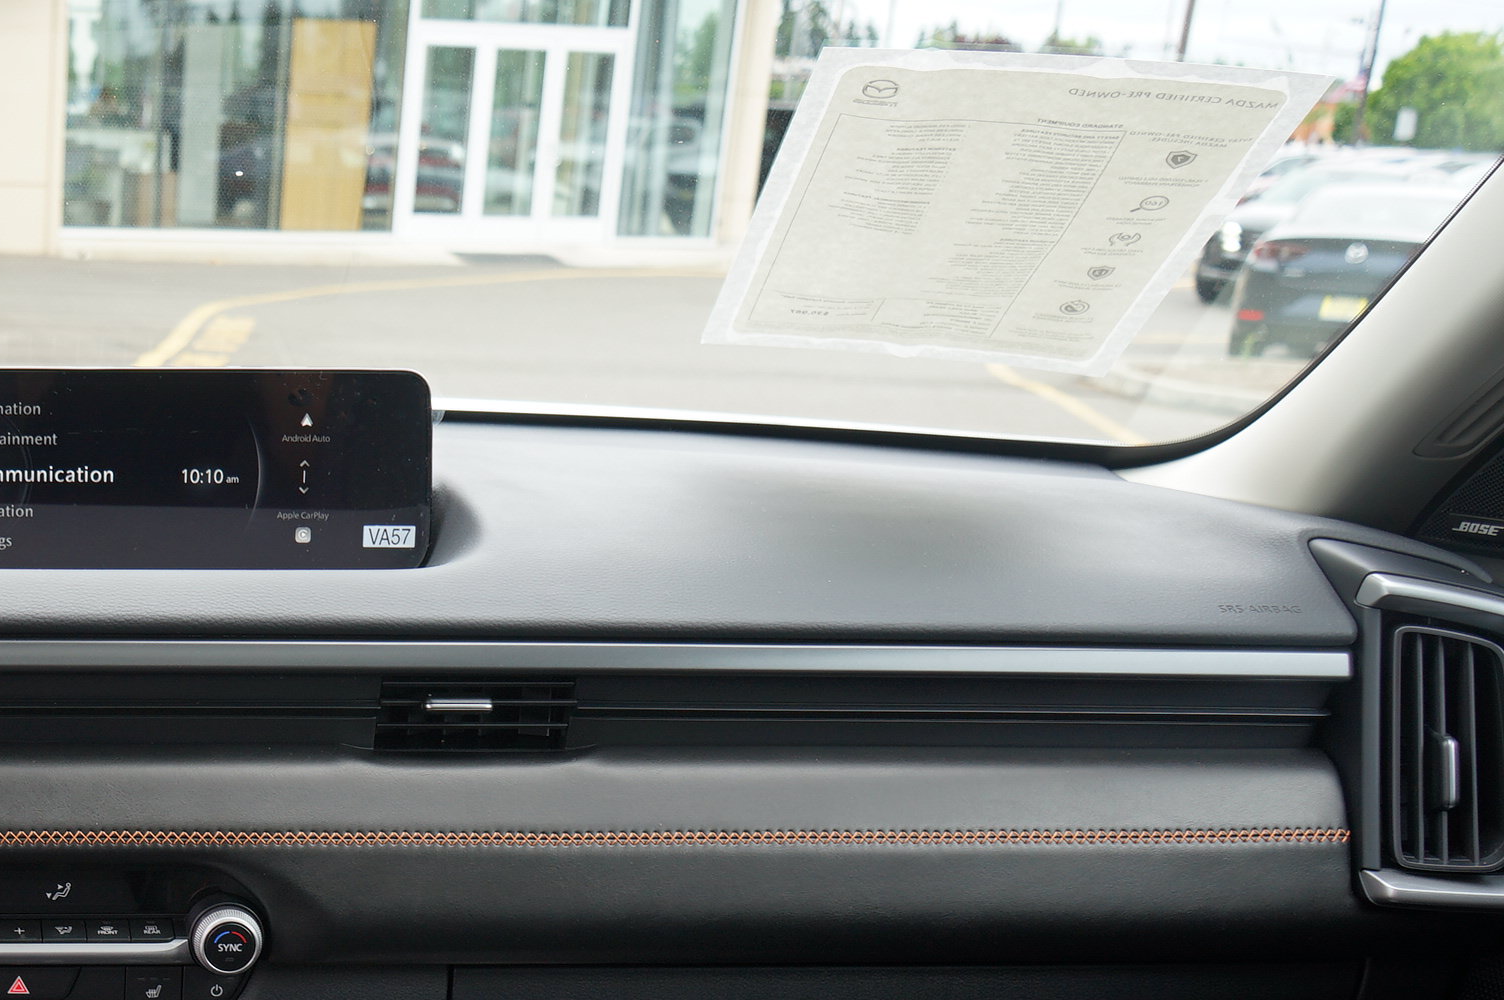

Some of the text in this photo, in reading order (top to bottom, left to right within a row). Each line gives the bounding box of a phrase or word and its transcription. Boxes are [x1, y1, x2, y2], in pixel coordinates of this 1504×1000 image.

[282, 435, 331, 443] Android Auto
[181, 468, 240, 484] 10:10 am
[277, 511, 330, 521] Apple CarPlay
[1452, 521, 1504, 536] BOSE
[368, 528, 411, 545] VA57
[217, 943, 243, 952] SYNC
